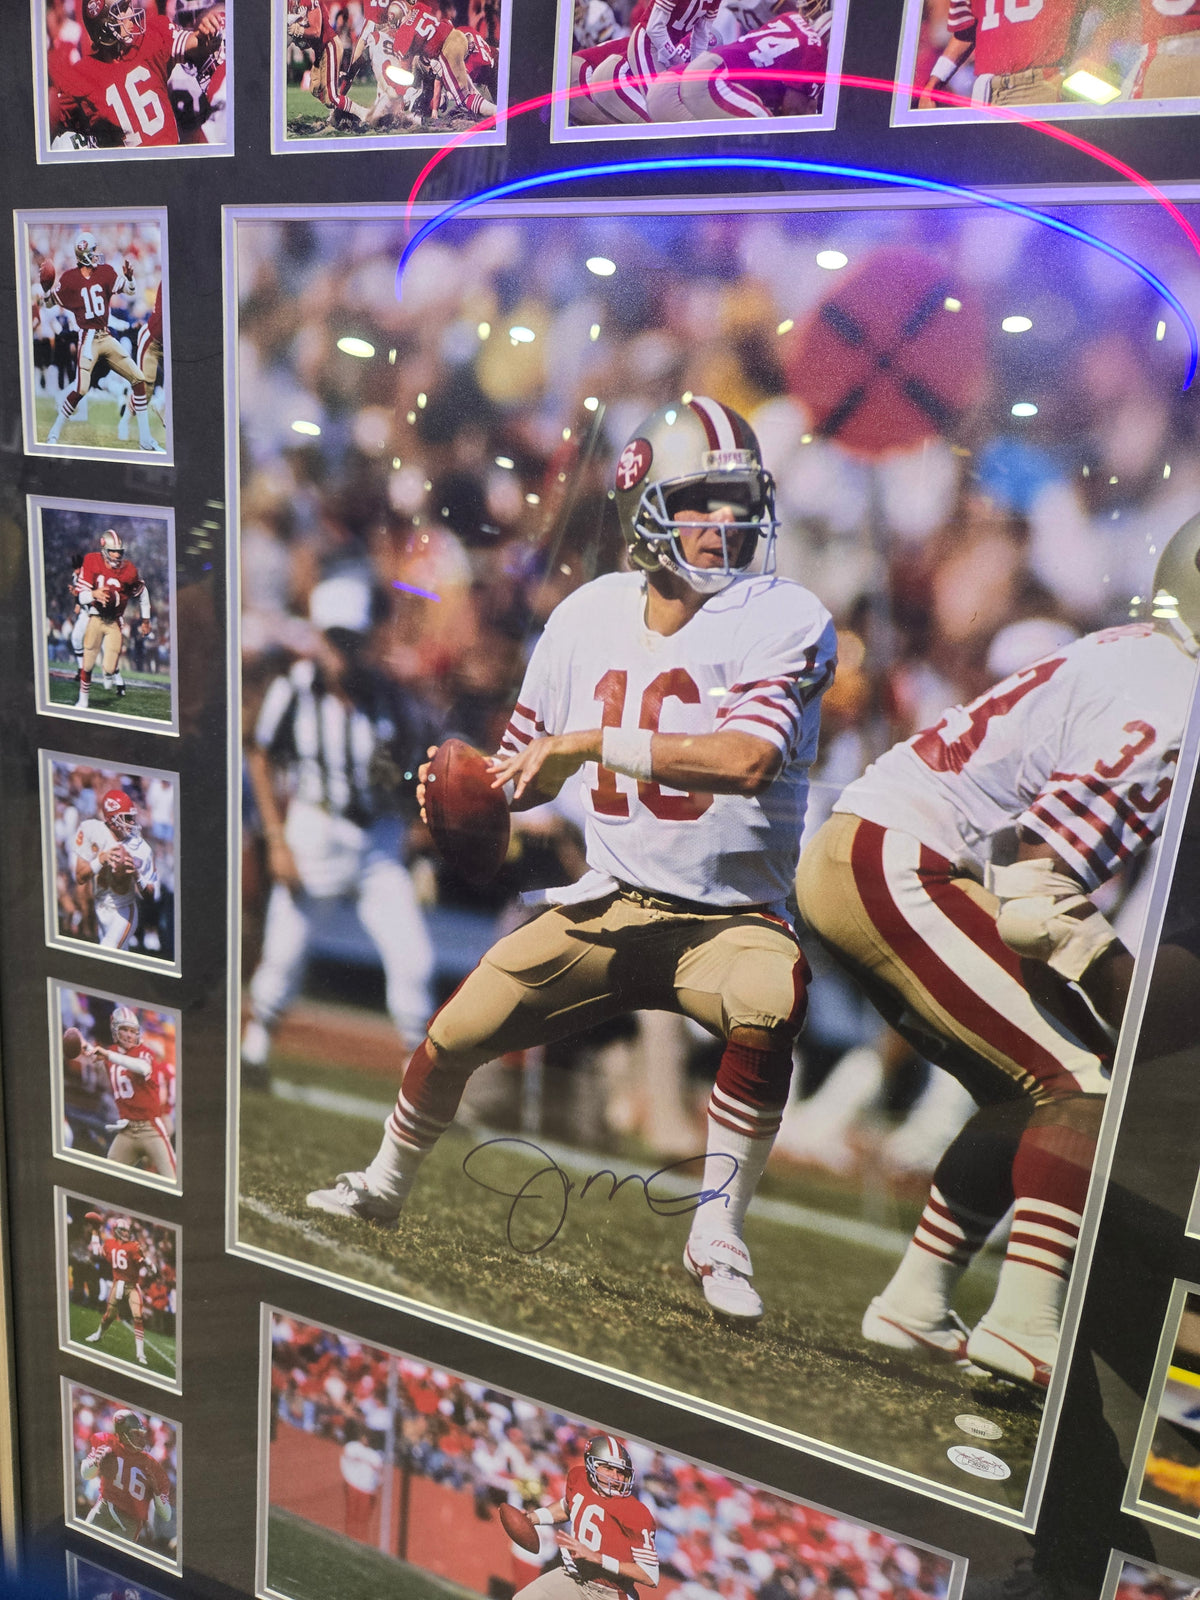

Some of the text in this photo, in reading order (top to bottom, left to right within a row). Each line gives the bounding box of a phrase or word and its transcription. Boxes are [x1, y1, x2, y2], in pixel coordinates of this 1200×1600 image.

[415, 12, 441, 41] 51
[738, 20, 800, 68] 74
[105, 65, 165, 147] 16
[81, 284, 105, 319] 16
[110, 1063, 135, 1100] 16
[111, 1248, 128, 1270] 16
[113, 1456, 148, 1502] 16
[570, 1493, 605, 1552] 16
